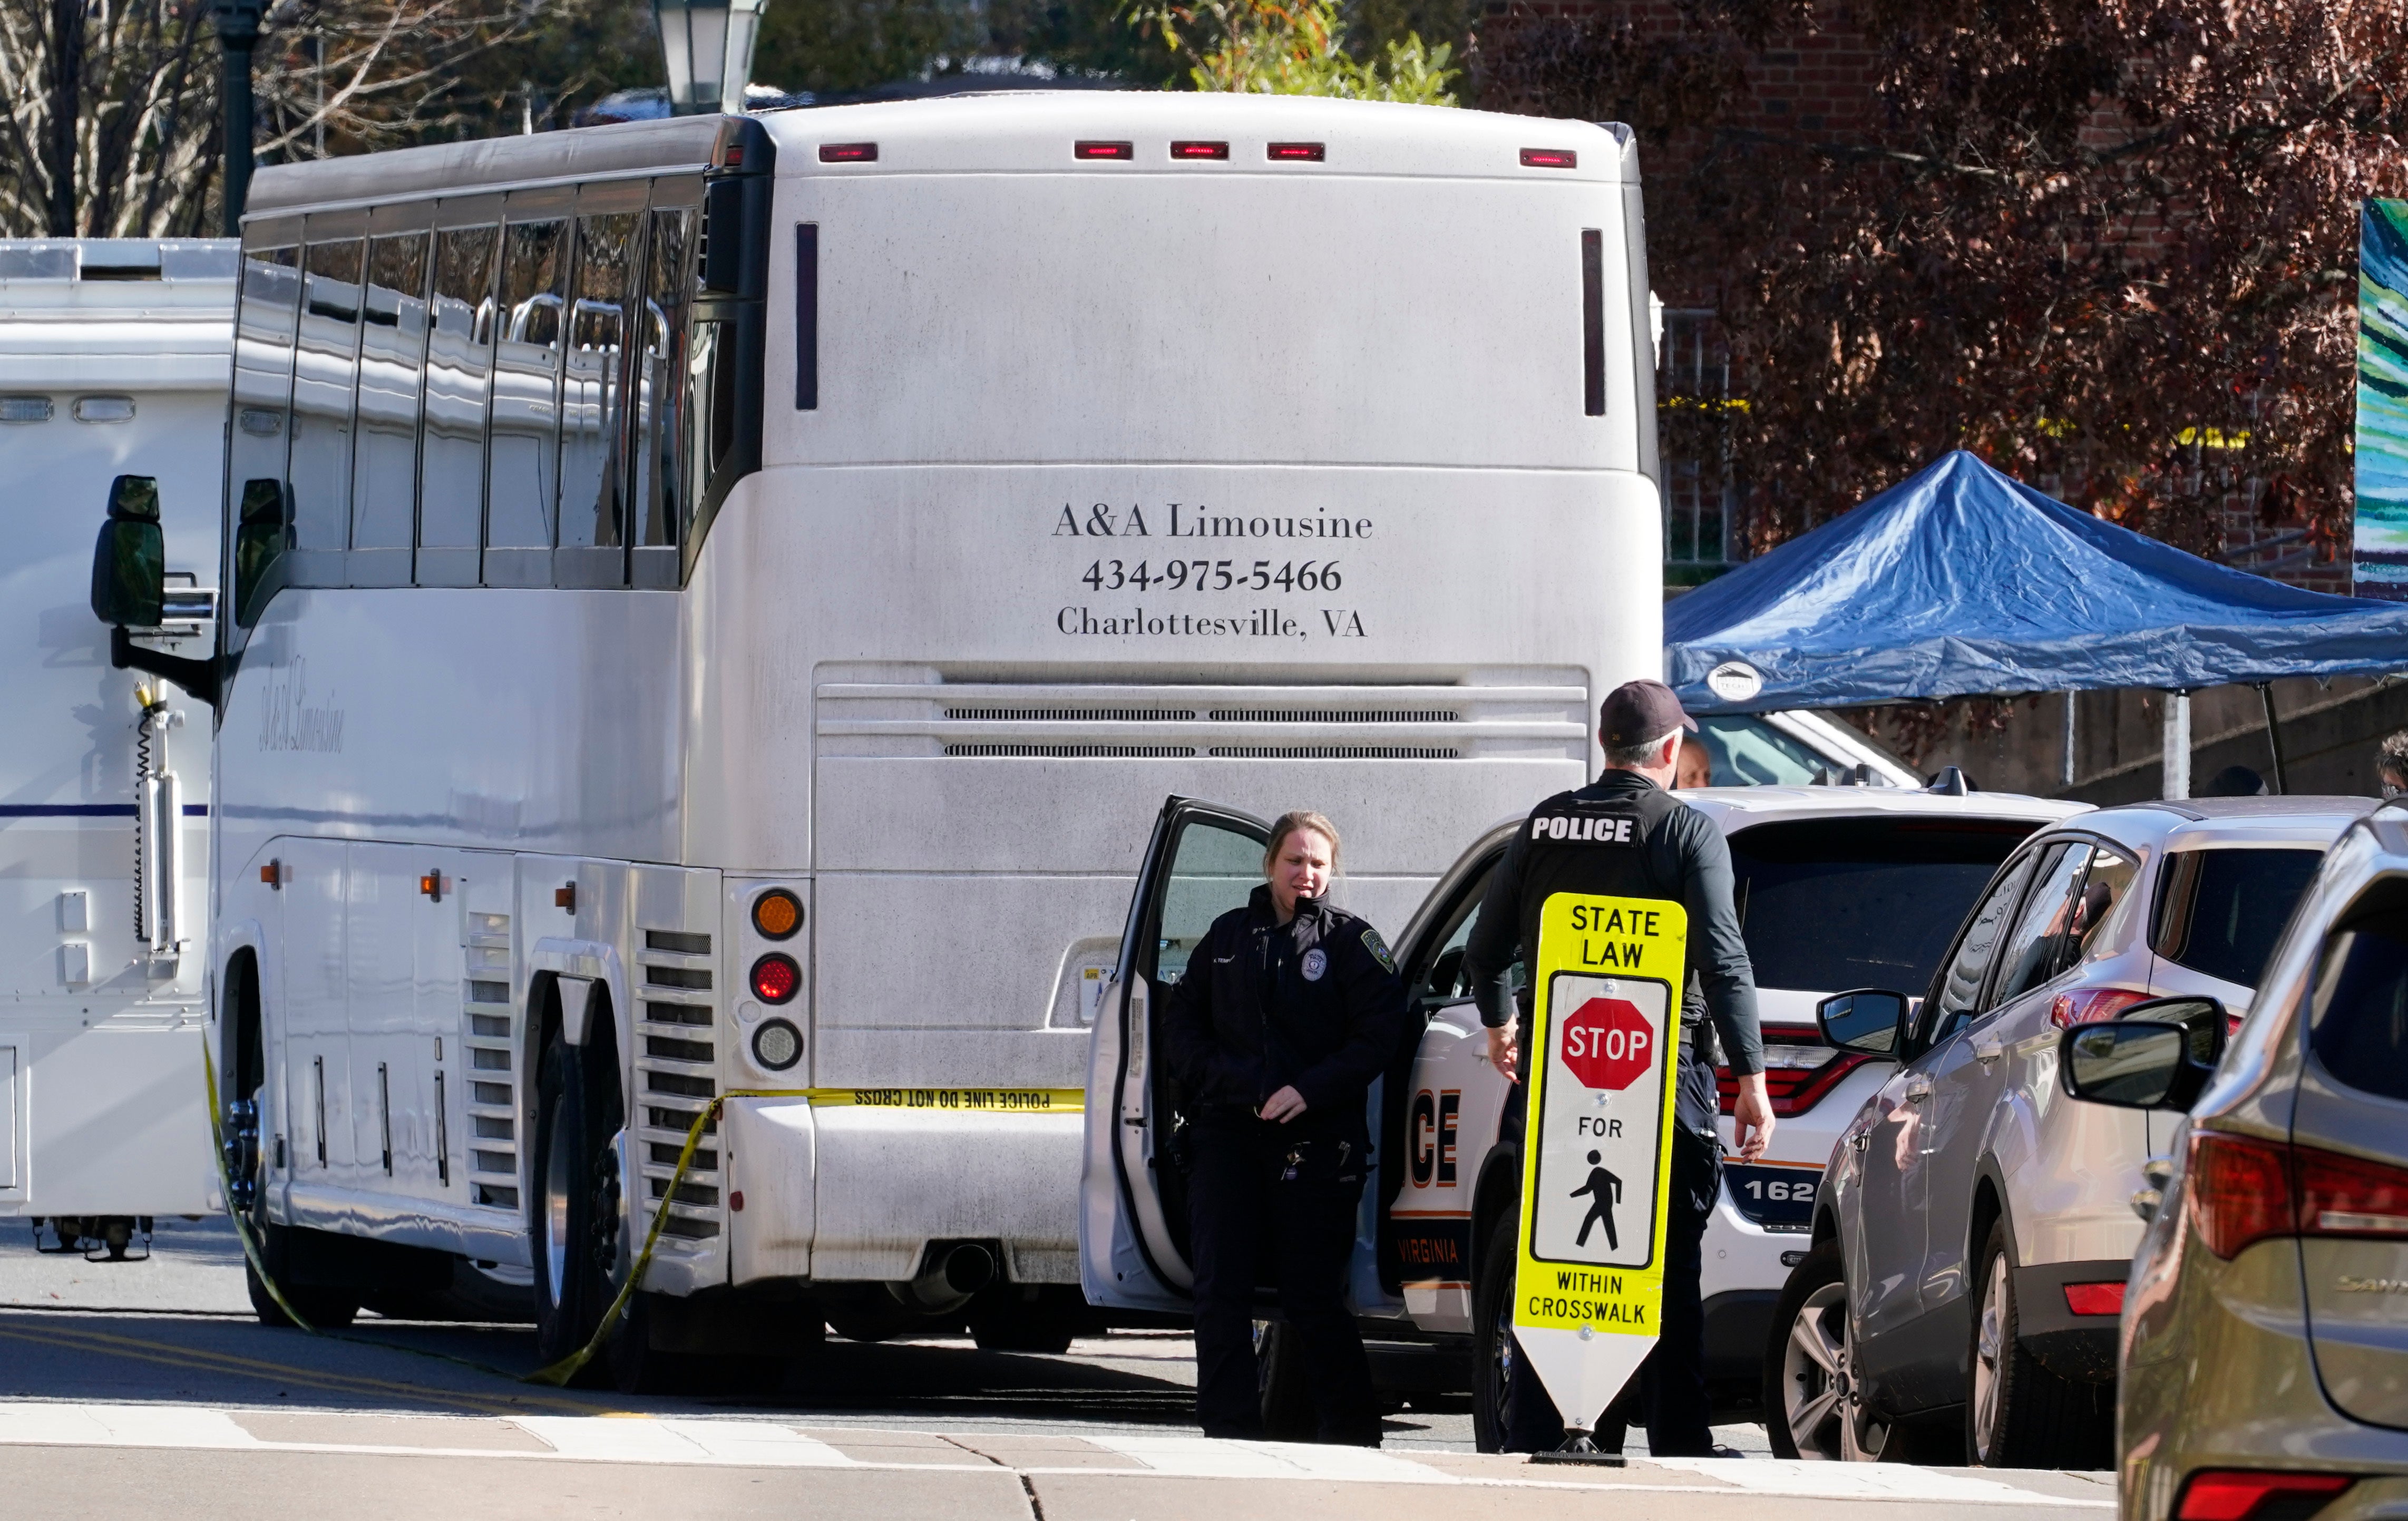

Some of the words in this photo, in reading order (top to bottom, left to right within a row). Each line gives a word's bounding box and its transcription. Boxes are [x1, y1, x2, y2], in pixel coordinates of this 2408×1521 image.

[1051, 502, 1152, 537] A&A
[1166, 503, 1373, 539] Limousine
[1082, 559, 1342, 592] 434-975-5466
[1057, 606, 1307, 642] Charlottesville,
[1320, 609, 1369, 637] VA
[1532, 815, 1633, 843] POLICE
[1571, 905, 1660, 937] STATE
[1582, 939, 1643, 969] LAW
[1567, 1025, 1648, 1061] STOP
[855, 1090, 902, 1106] CROSS
[907, 1090, 934, 1107] NOT
[940, 1090, 958, 1108] DO
[964, 1091, 995, 1109] LINE
[1000, 1092, 1050, 1109] POLICE
[1409, 1088, 1461, 1188] CE
[1578, 1116, 1623, 1139] FOR
[1744, 1180, 1814, 1202] 162
[1398, 1239, 1458, 1263] VIRGINIA
[1556, 1270, 1623, 1295] WITHIN
[1528, 1296, 1646, 1324] CROSSWALK
